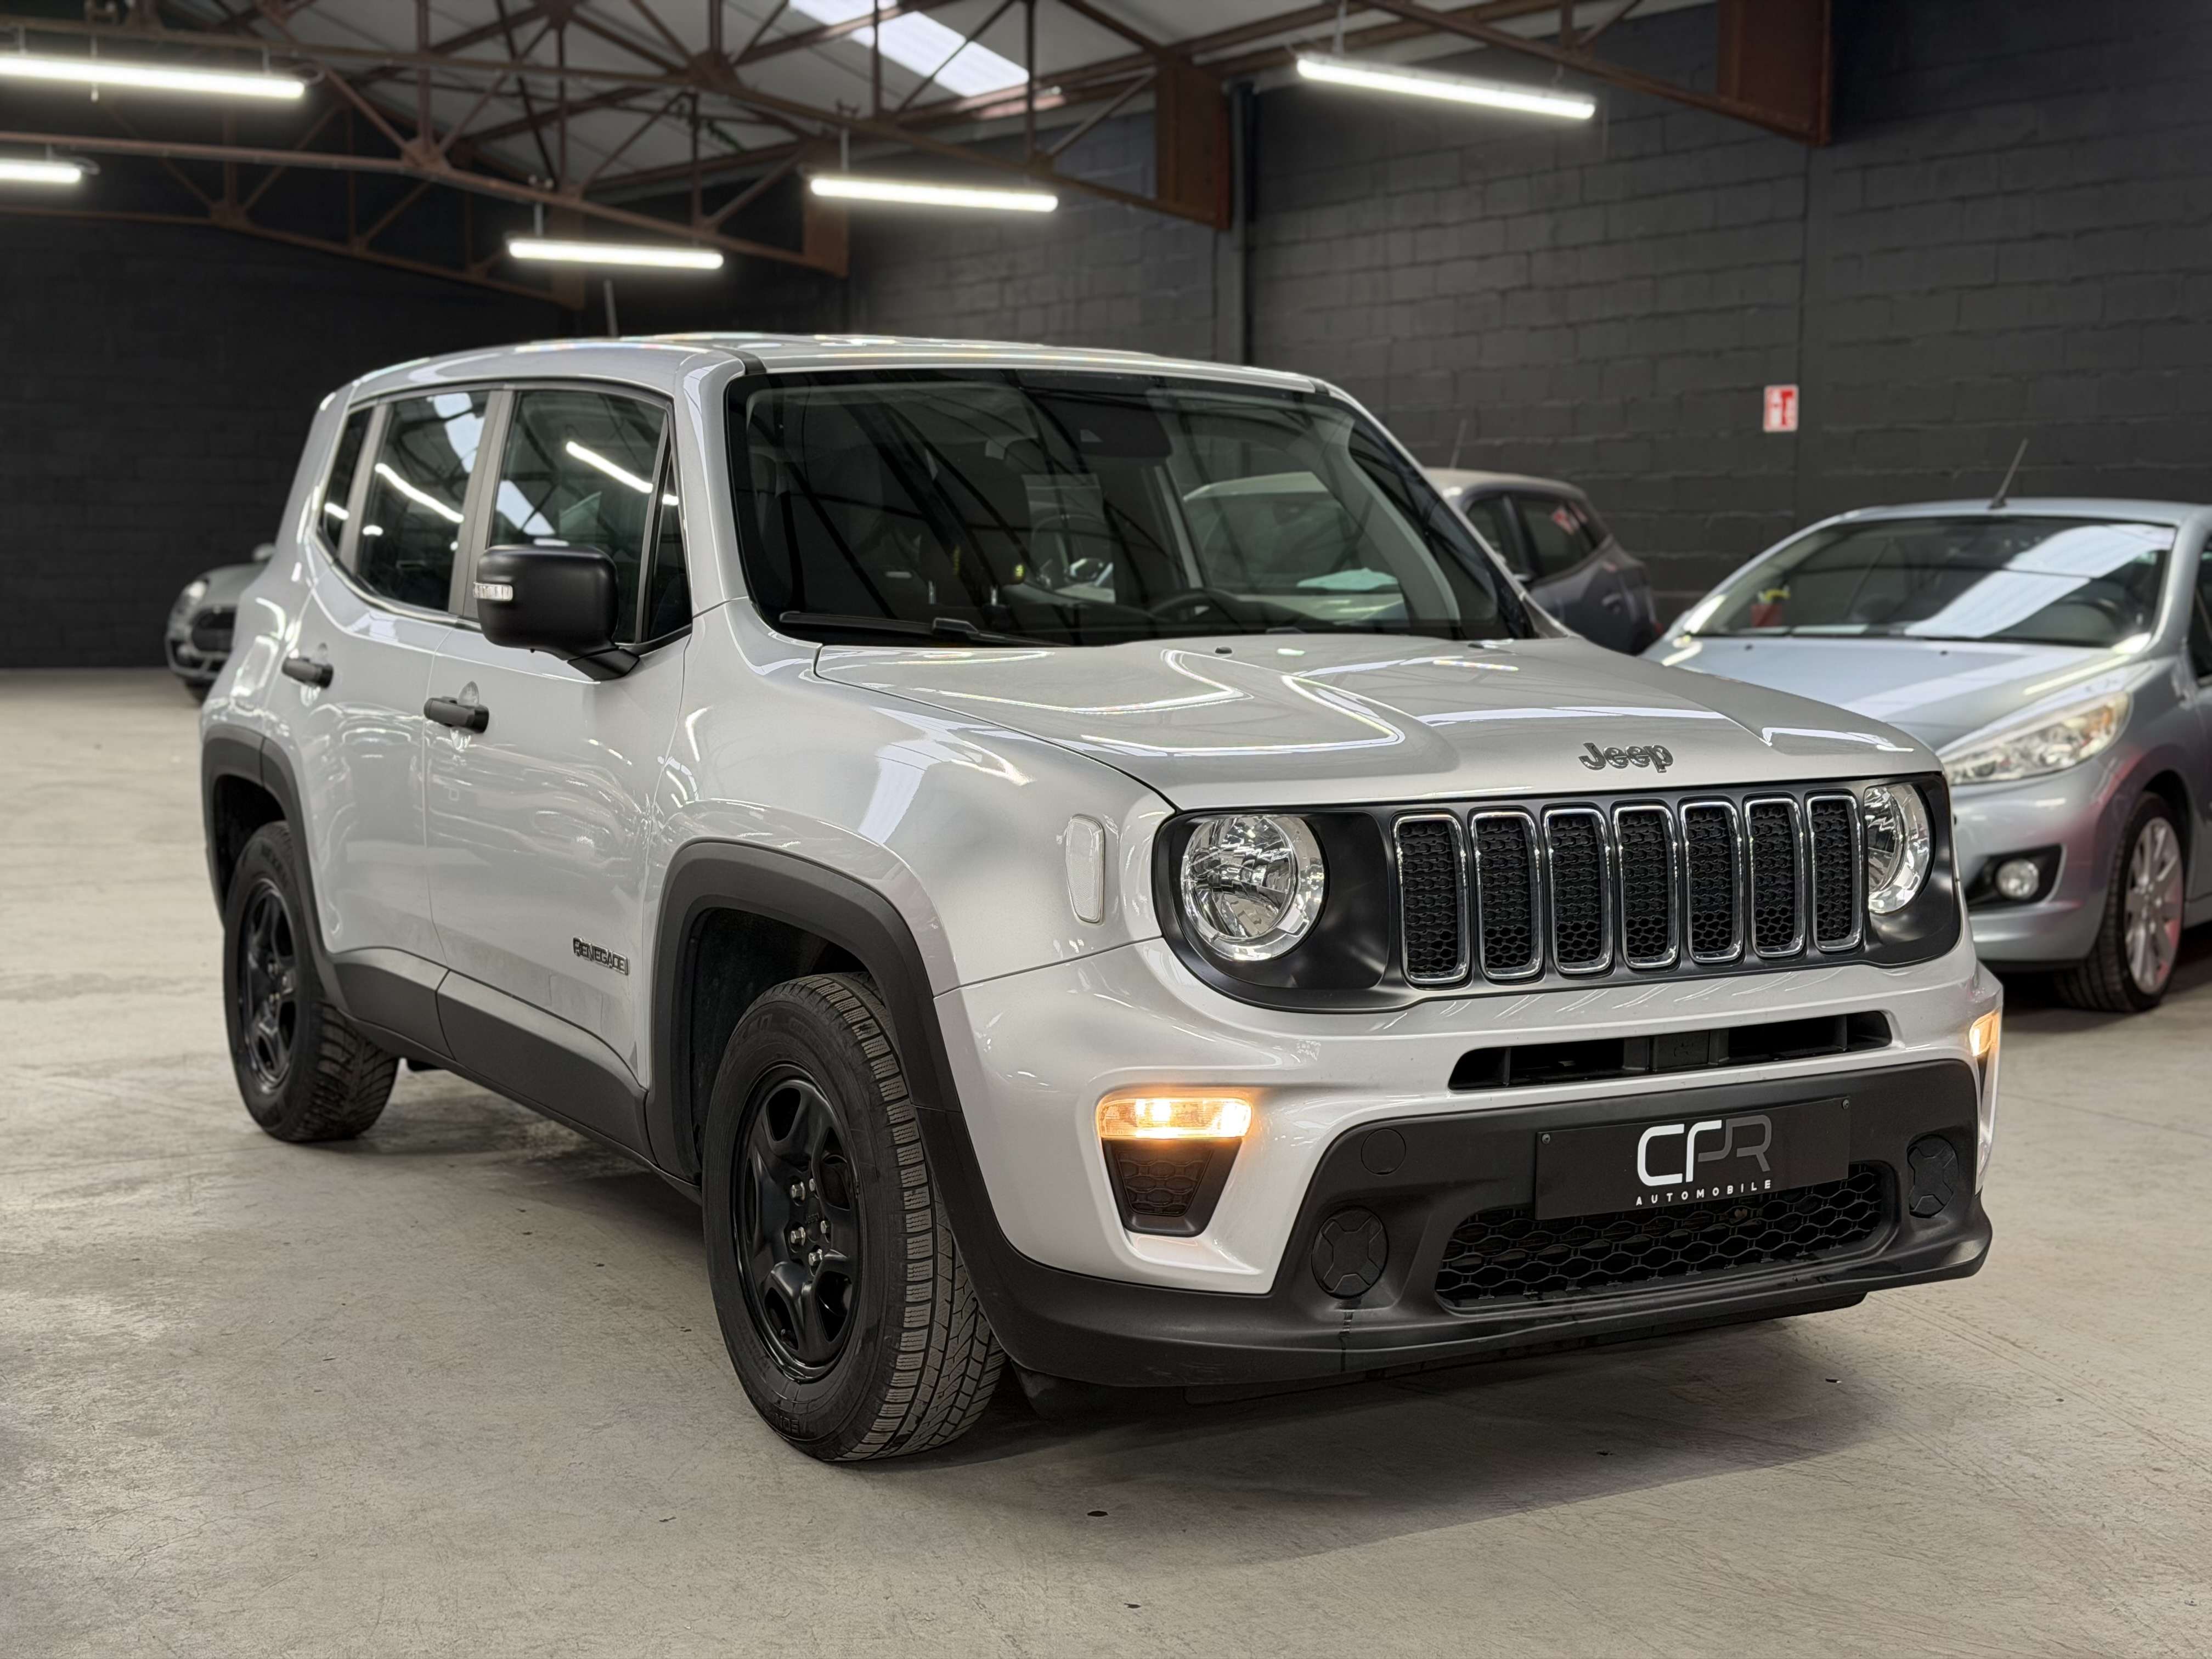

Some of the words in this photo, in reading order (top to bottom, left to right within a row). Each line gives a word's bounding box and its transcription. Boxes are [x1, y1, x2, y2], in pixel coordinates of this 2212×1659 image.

[1578, 742, 1674, 774] Jeep
[572, 936, 629, 975] RENEGADE
[1637, 1114, 1773, 1187] CPR
[1635, 1179, 1773, 1206] AUTOMOBILE
